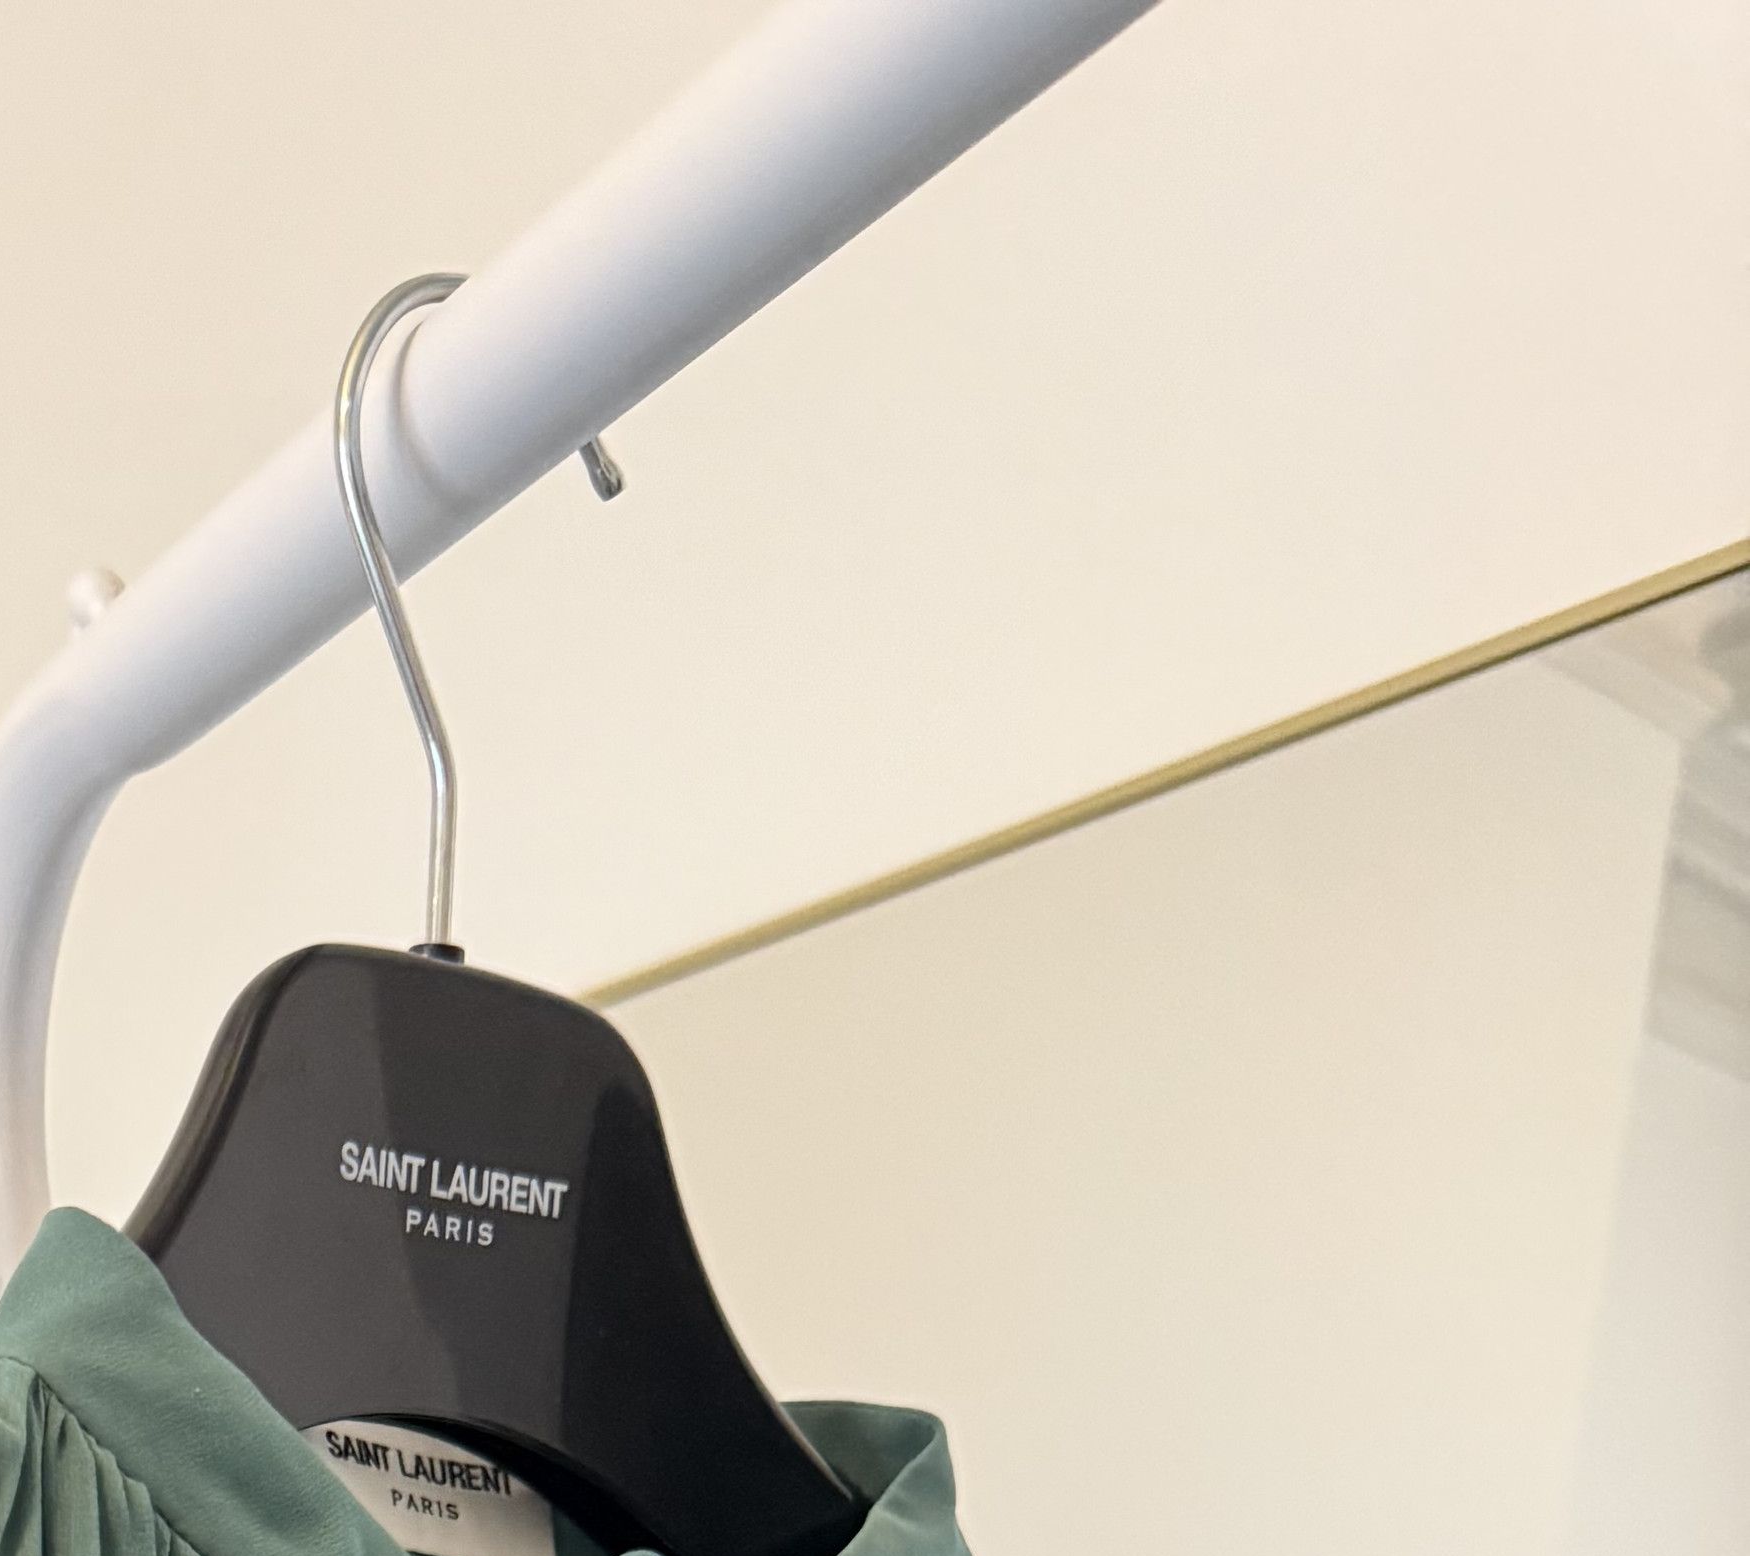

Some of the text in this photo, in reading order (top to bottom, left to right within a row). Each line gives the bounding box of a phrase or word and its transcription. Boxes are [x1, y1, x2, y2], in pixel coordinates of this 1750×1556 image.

[339, 1140, 569, 1219] SAINT LAURENT
[405, 1207, 494, 1246] PARIS
[325, 1430, 390, 1472] SAINT
[390, 1488, 460, 1520] PARIS
